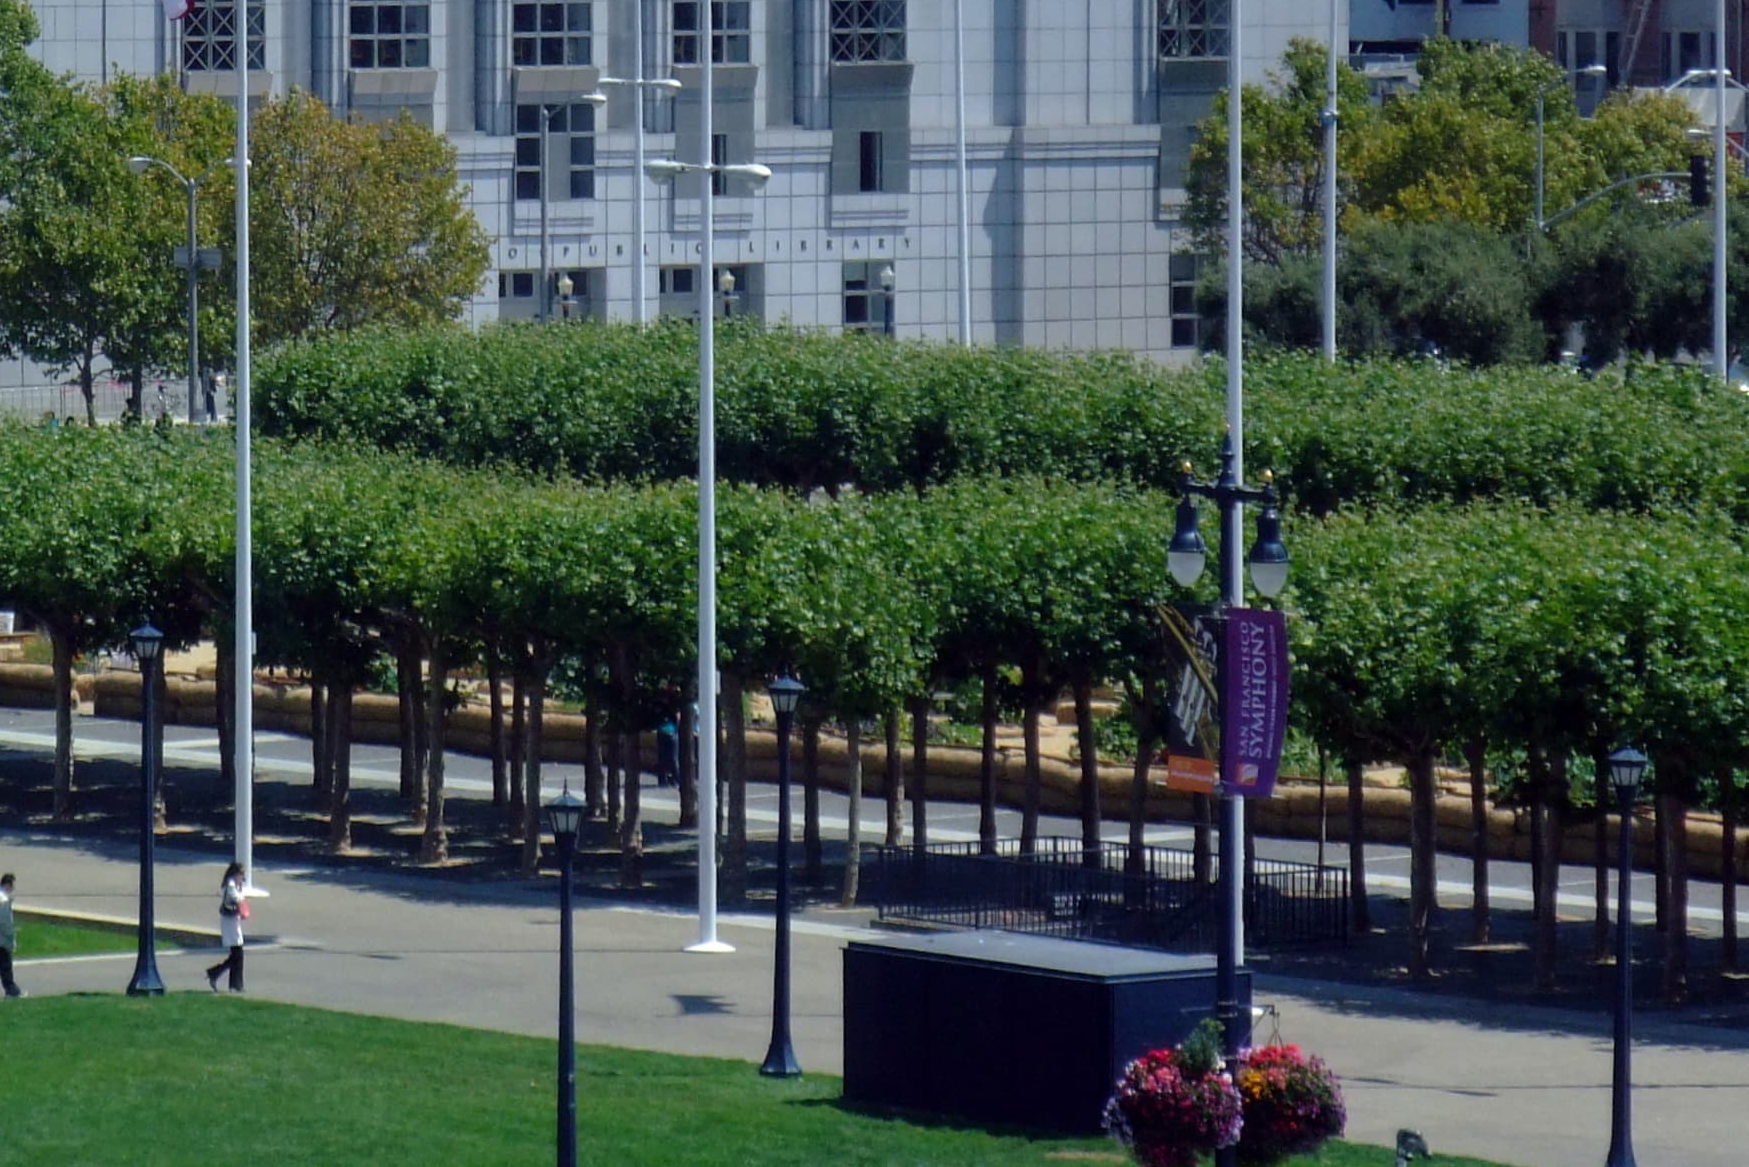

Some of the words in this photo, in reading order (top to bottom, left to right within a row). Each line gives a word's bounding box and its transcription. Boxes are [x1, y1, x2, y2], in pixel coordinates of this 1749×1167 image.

[749, 237, 911, 253] LIBRARY
[1240, 621, 1250, 717] FRANCISCO
[1249, 621, 1267, 759] SYMPHONY
[1238, 726, 1249, 756] SAN
